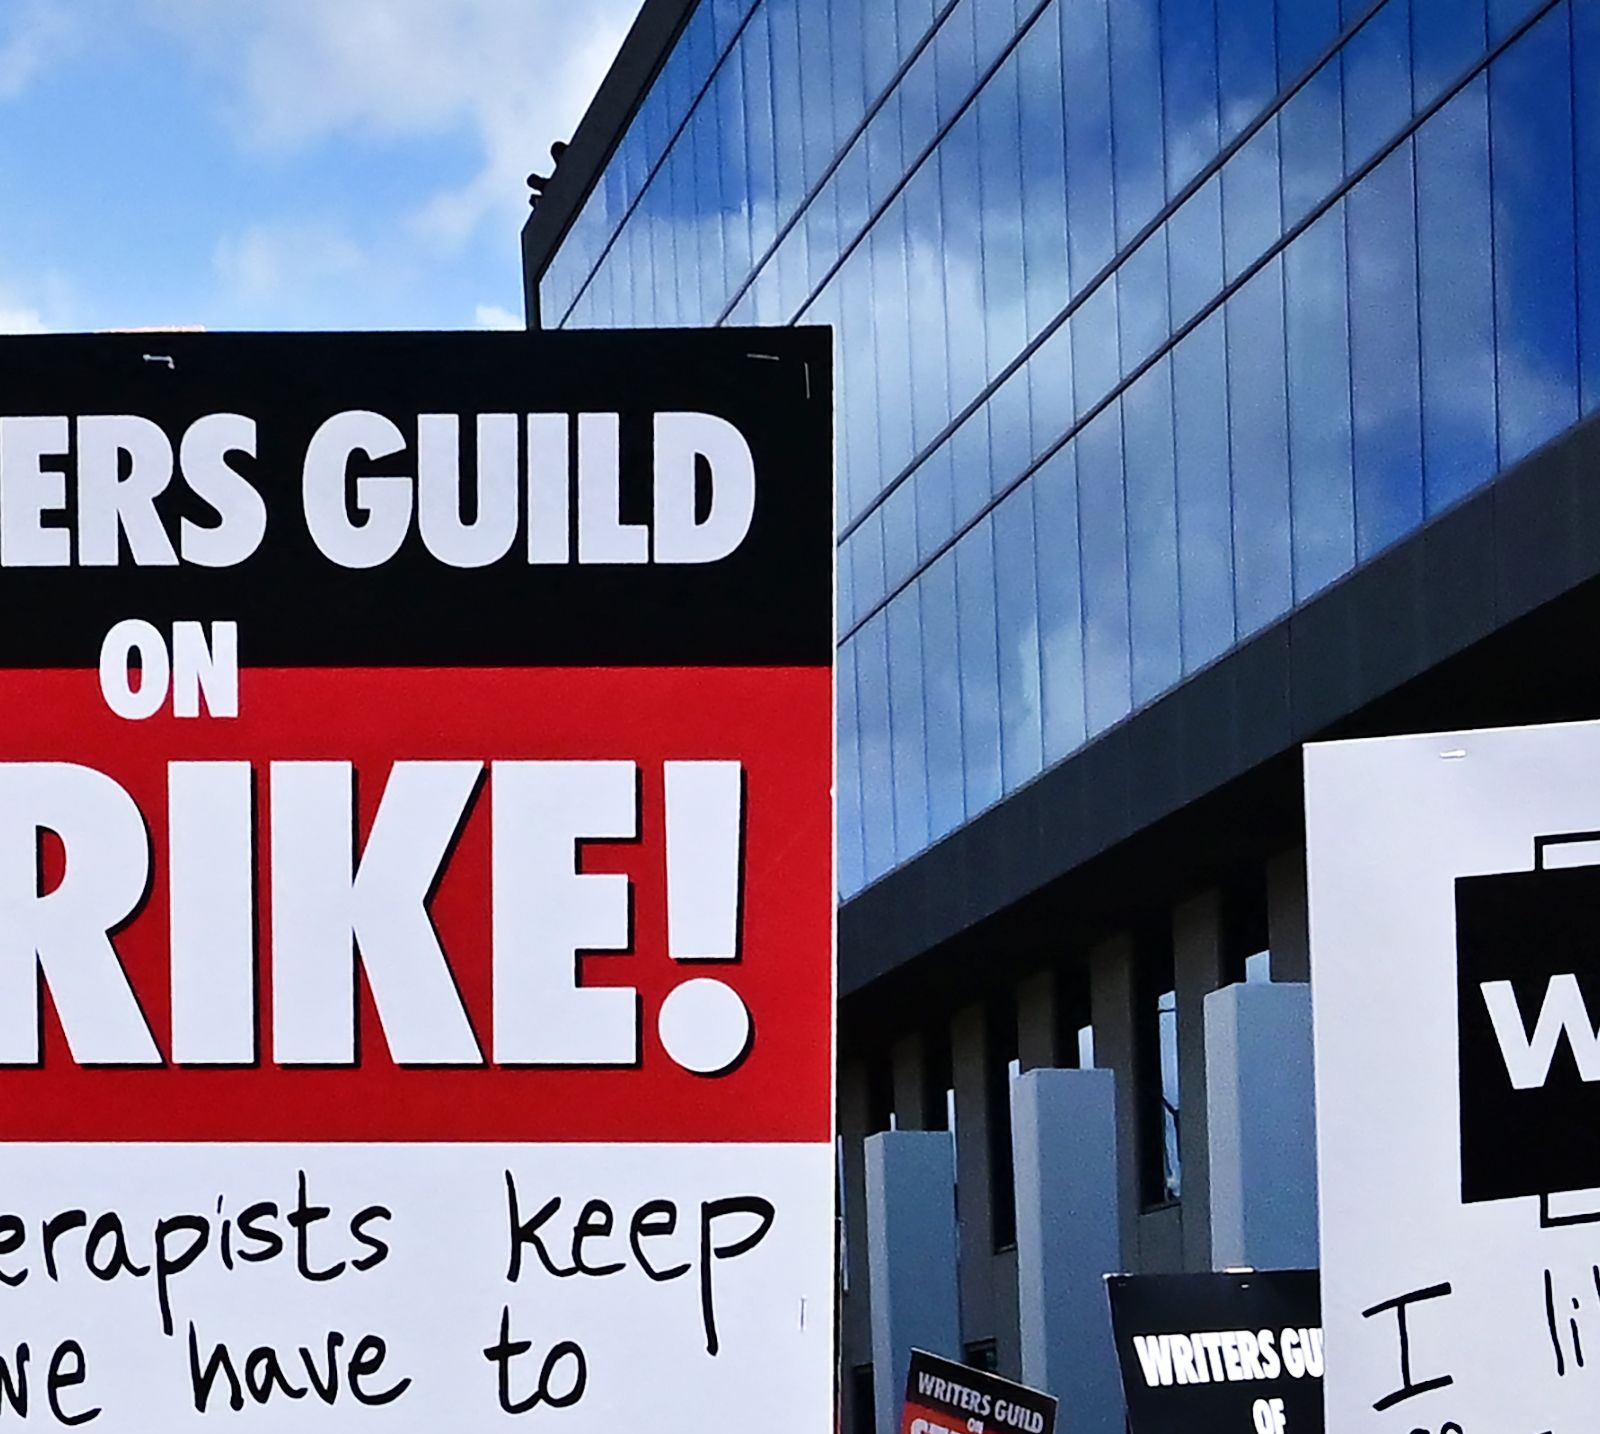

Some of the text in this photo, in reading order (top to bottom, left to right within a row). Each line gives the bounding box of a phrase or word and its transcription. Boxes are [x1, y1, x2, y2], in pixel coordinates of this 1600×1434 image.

[303, 410, 755, 569] GUILD
[99, 618, 238, 720] ON
[505, 1170, 776, 1357] keep
[189, 1321, 412, 1413] have
[483, 1305, 587, 1415] to
[1133, 1328, 1282, 1388] WRITERS
[1361, 1281, 1453, 1412] I
[918, 1371, 1045, 1434] WRITERS GUILD
